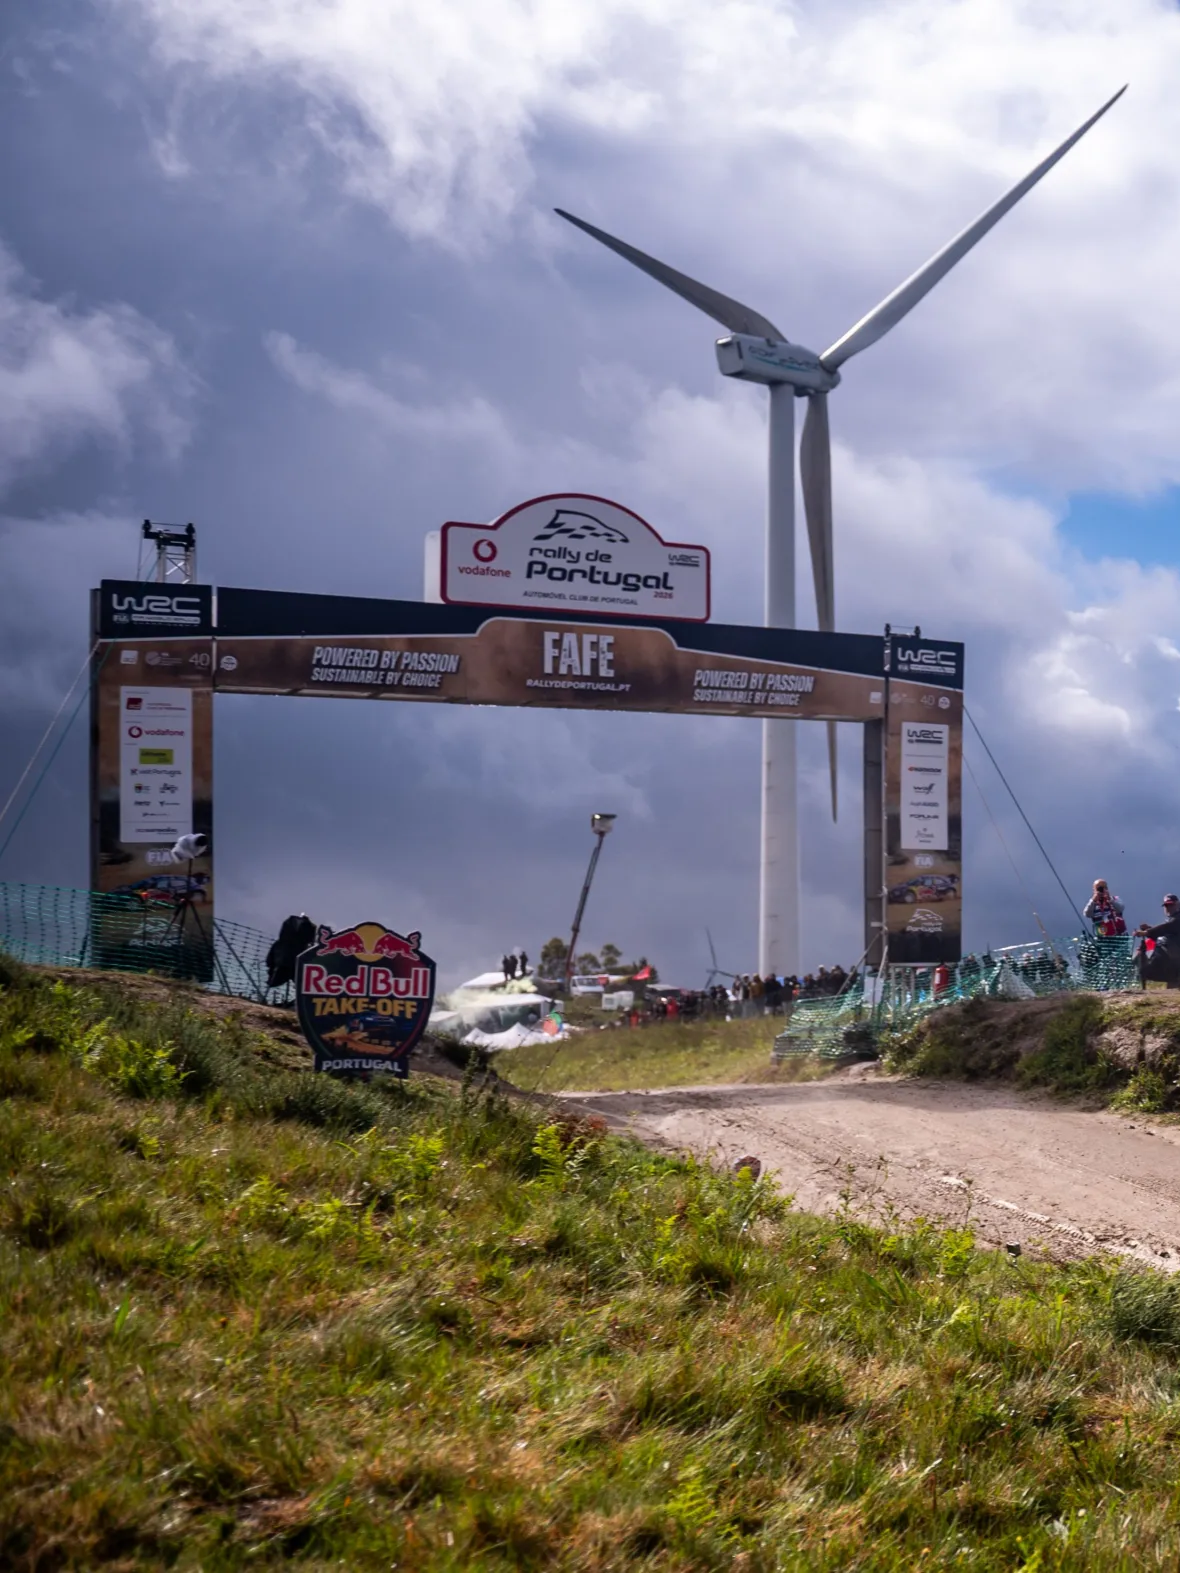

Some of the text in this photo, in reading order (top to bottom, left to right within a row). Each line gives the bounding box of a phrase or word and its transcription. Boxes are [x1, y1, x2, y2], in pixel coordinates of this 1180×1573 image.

[529, 547, 612, 563] rally de
[668, 553, 699, 563] WRC
[458, 565, 511, 578] vodafone
[526, 560, 674, 592] Portugal
[112, 593, 201, 614] WRC
[523, 590, 638, 606] AUTOMÓVEL CLUB DE PORTUGAL
[312, 646, 460, 672] POWERED BY PASSION
[544, 631, 614, 677] FAFE
[897, 647, 956, 665] WRC
[311, 668, 442, 687] SUSTAINABLE BY CHOICE
[526, 679, 631, 692] RALLYDEPORTUGAL.PT
[693, 669, 814, 692] POWERED BY PASSION
[693, 689, 800, 705] SUSTAINABLE BY CHOICE
[145, 729, 185, 737] vodafone
[907, 729, 943, 739] WRC
[303, 965, 429, 996] Red Bull
[312, 997, 417, 1019] TAKE-OFF
[322, 1058, 402, 1072] PORTUGAL
